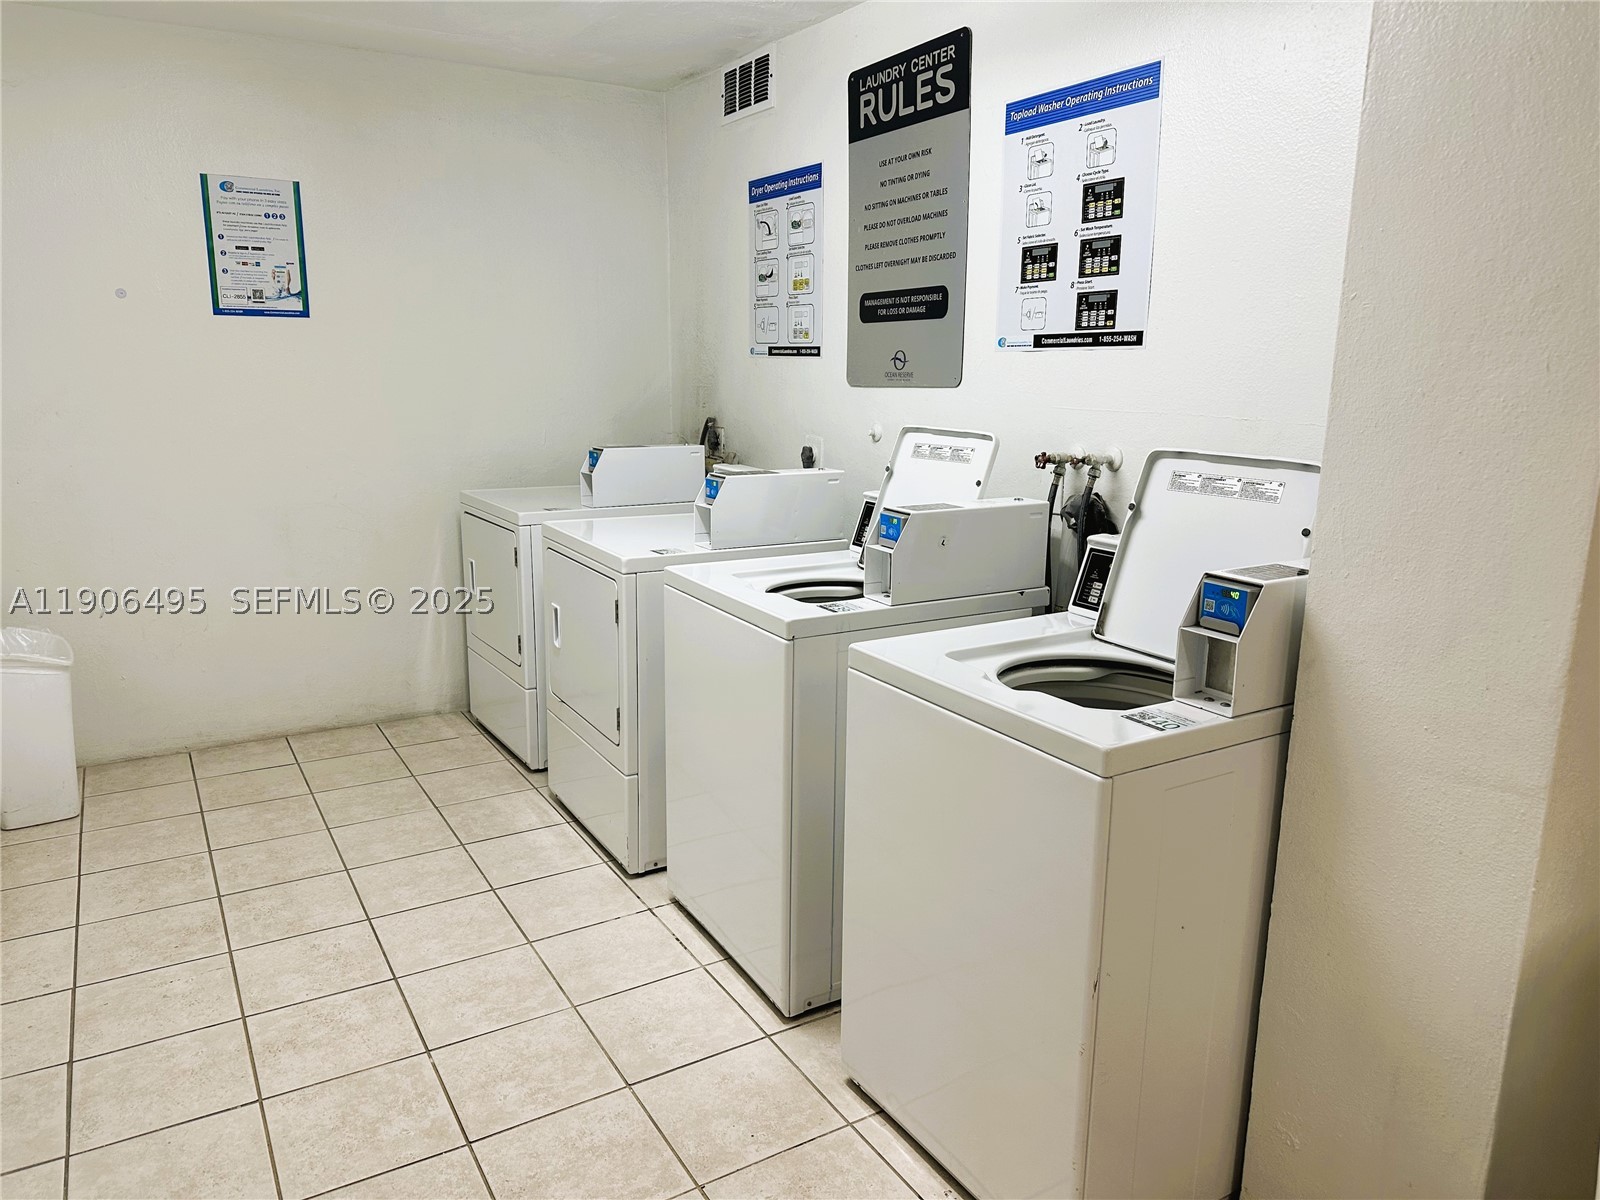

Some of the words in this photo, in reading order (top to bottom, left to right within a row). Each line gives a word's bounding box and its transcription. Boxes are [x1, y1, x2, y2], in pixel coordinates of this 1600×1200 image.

[860, 62, 907, 92] LAUNDRY
[910, 44, 956, 72] CENTER
[860, 63, 956, 128] RULES
[1010, 105, 1037, 122] Topload
[1038, 98, 1064, 114] Washer
[1065, 90, 1103, 108] Operating
[1104, 76, 1154, 96] Instructions
[879, 159, 887, 168] USE
[888, 157, 894, 165] AT
[895, 155, 907, 164] YOUR
[908, 151, 920, 160] OWN
[921, 148, 932, 157] RISK
[751, 187, 764, 196] Dryer
[764, 180, 788, 193] Operating
[788, 173, 819, 187] Instructions
[888, 176, 906, 186] TINTING
[915, 170, 930, 179] DYING
[872, 200, 888, 210] SITTING
[897, 193, 921, 205] MACHINES
[930, 187, 948, 197] TABLES
[864, 223, 878, 231] PLEASE
[886, 219, 896, 227] NOT
[897, 214, 921, 225] OVERLOAD
[922, 209, 948, 220] MACHINES
[880, 240, 898, 248] REMOVE
[898, 236, 919, 245] CLOTHES
[920, 232, 946, 242] PROMPTLY
[855, 262, 873, 271] CLOTHES
[874, 261, 883, 269] LEFT
[884, 257, 910, 268] OVERNIGHT
[911, 256, 921, 264] MAY
[928, 252, 956, 262] DISCARDED
[864, 297, 894, 306] MANAGEMENT
[911, 293, 942, 303] RESPONSIBLE
[1099, 334, 1137, 342] 1-855-254-WASH
[1231, 591, 1240, 600] 40
